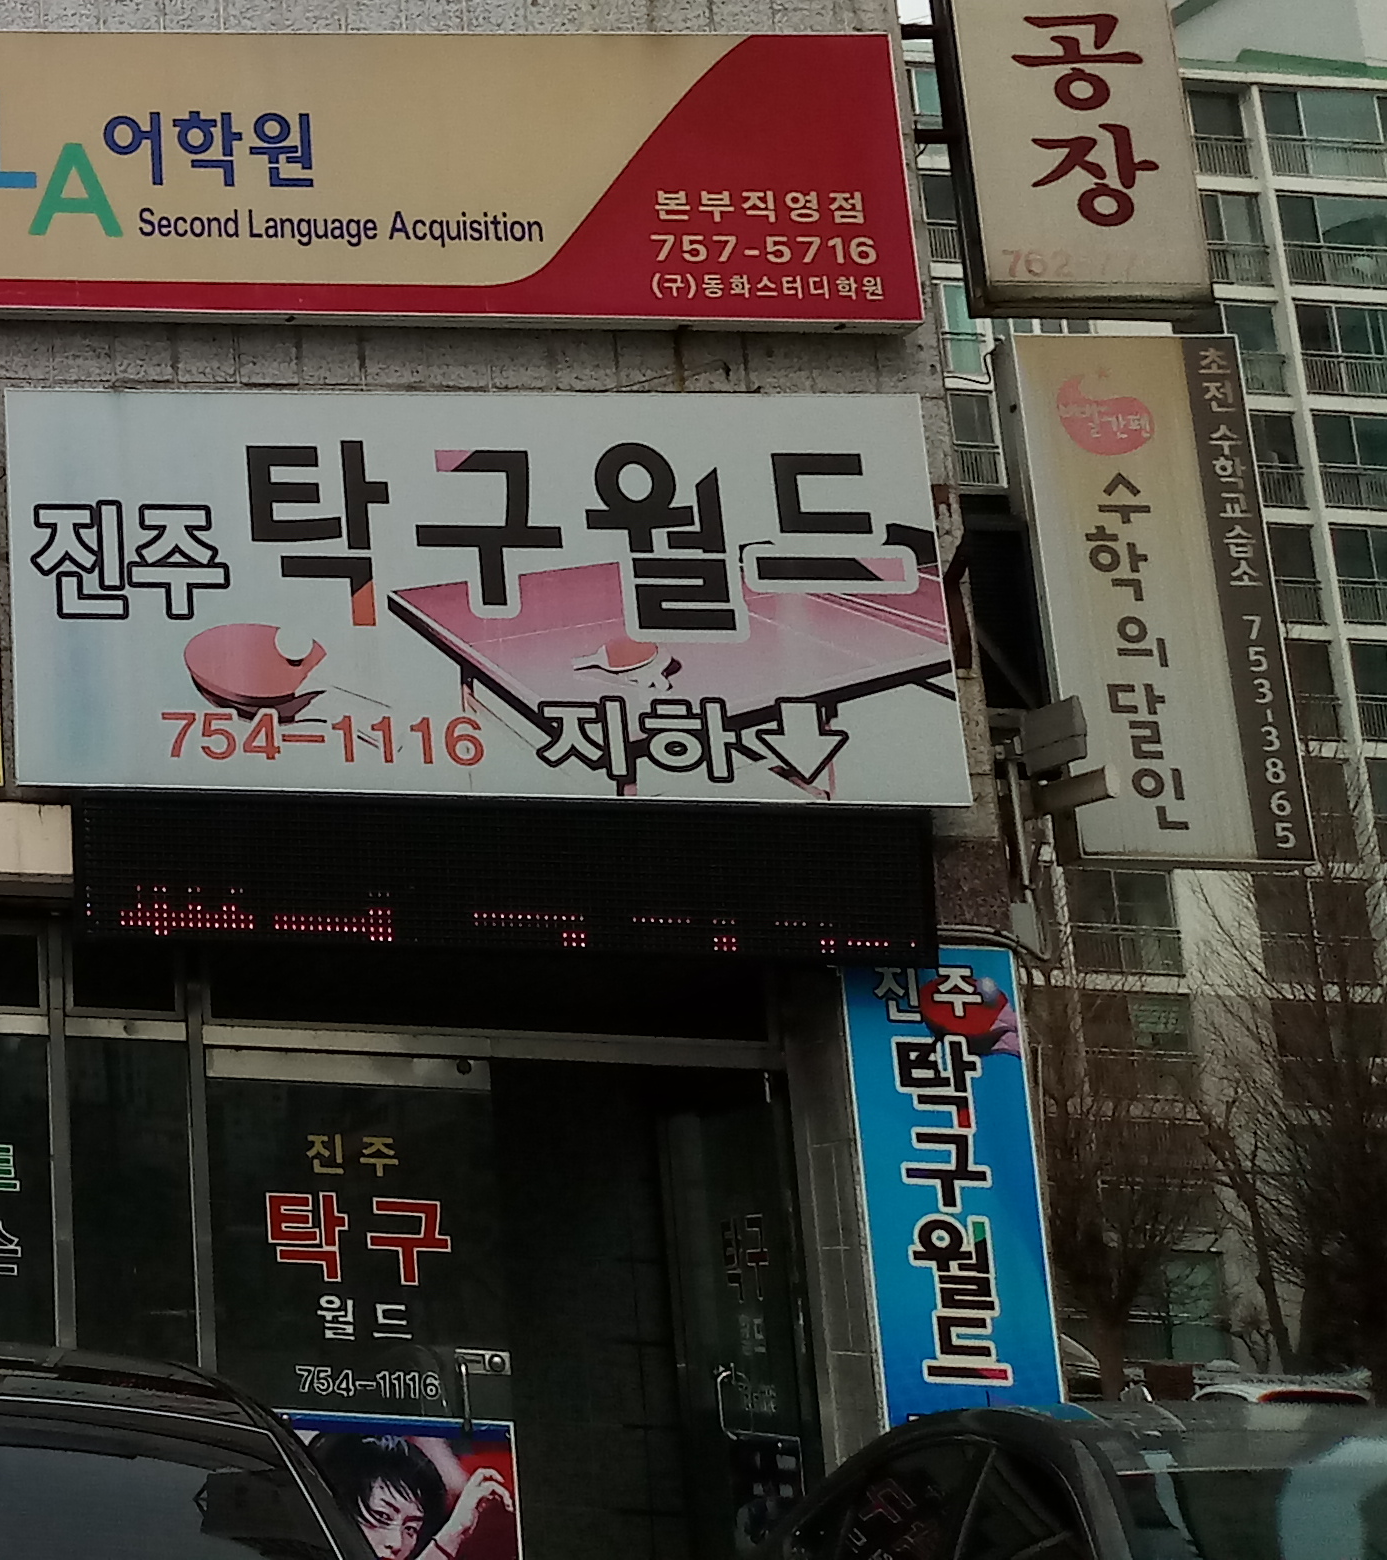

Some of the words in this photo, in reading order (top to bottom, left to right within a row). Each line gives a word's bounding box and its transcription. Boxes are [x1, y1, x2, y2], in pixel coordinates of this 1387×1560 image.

[102, 109, 316, 188] 어학원
[137, 206, 241, 241] Second
[247, 208, 379, 249] Language
[387, 210, 545, 245] Acquisition
[654, 189, 866, 225] 본부직영점
[649, 233, 879, 266] 757-5716
[650, 272, 886, 301] (구)동화스터디학원
[30, 498, 232, 622] 진주
[244, 438, 917, 634] 탁구월드
[158, 707, 487, 768] 754-1116
[537, 695, 741, 784] 지하
[304, 1133, 400, 1178] 진주
[888, 1033, 1015, 1387] 탁구월드
[264, 1190, 453, 1287] 탁구
[315, 1293, 414, 1341] 월드
[294, 1365, 443, 1401] 754-1116
